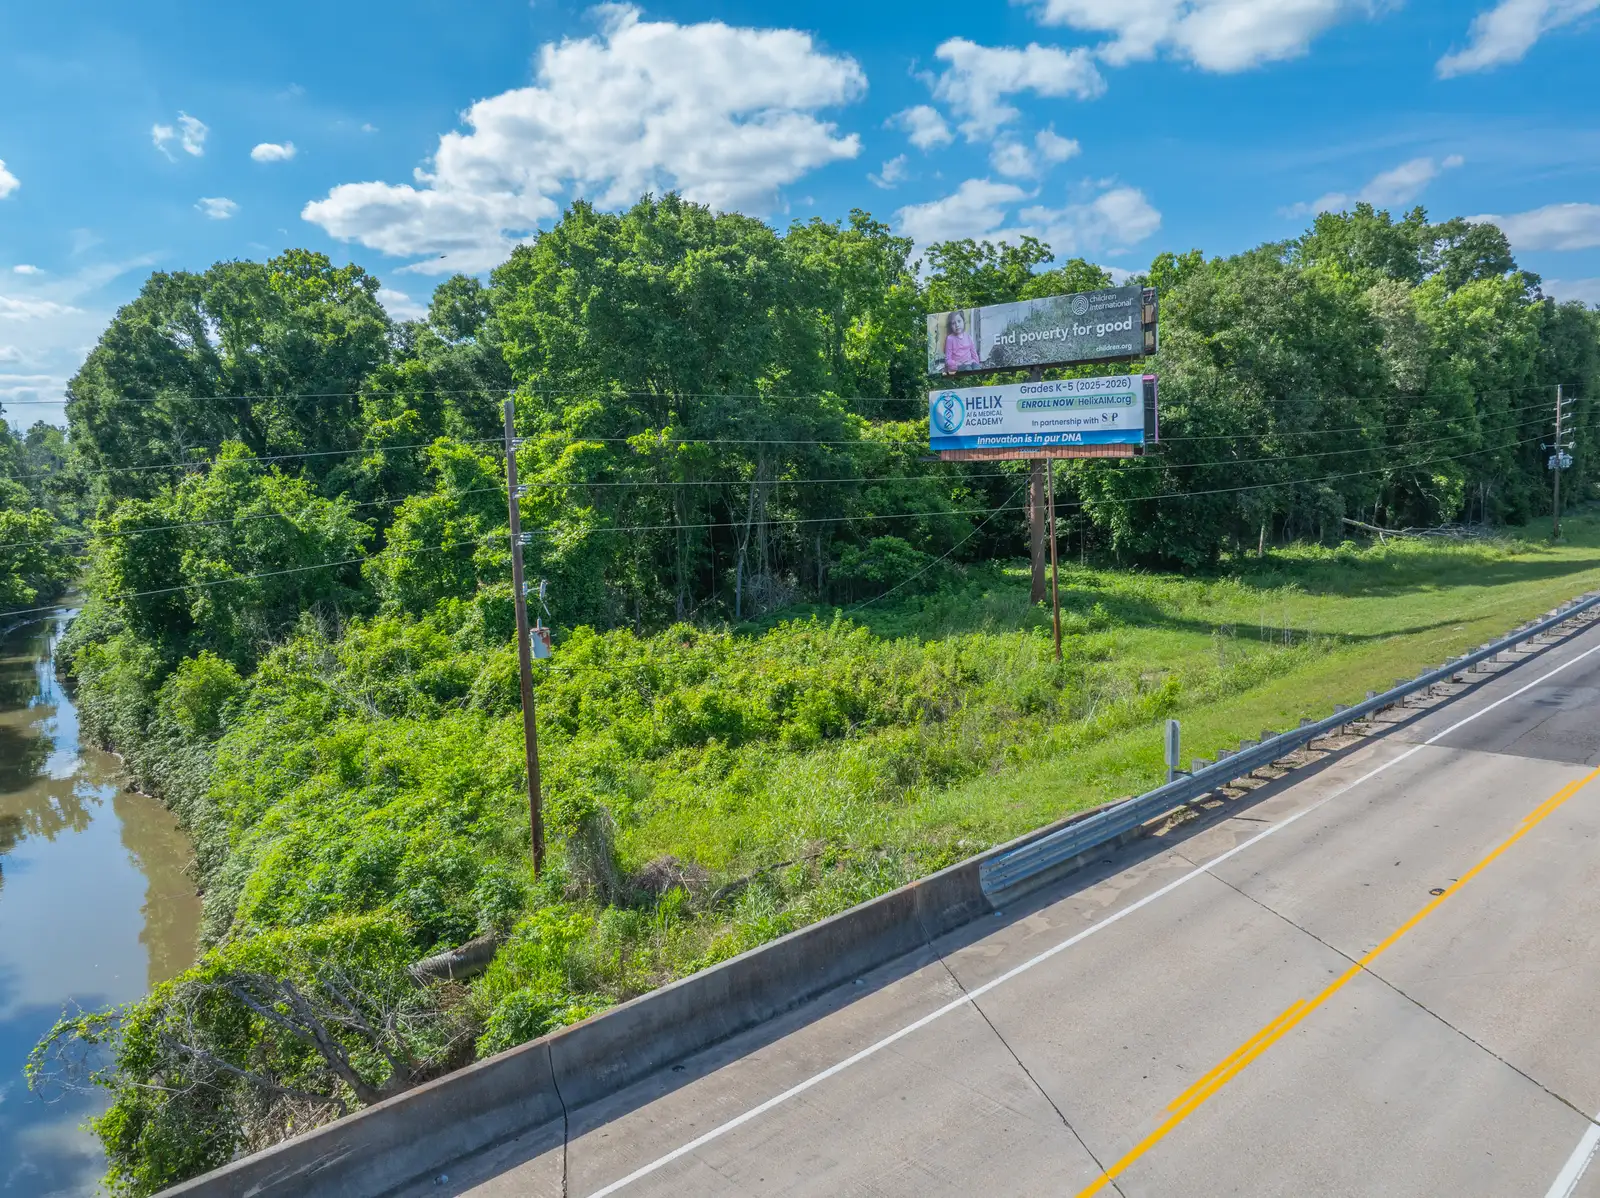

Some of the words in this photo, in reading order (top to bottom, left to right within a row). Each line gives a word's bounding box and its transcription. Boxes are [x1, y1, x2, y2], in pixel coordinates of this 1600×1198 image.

[1090, 294, 1116, 302] children
[994, 332, 1015, 345] End
[1020, 328, 1068, 346] poverty
[1072, 322, 1092, 336] for
[1096, 316, 1132, 337] good
[1096, 343, 1132, 352] children.org
[1020, 385, 1053, 393] Grades
[1056, 382, 1074, 391] K-5
[1076, 377, 1131, 391] (2025-2026)
[966, 396, 1002, 410] HELIX
[1021, 400, 1052, 408] ENROLL
[1053, 398, 1074, 407] NOW
[1078, 395, 1131, 407] HelixAIM.org
[966, 418, 1004, 426] ACADEMY
[1040, 418, 1081, 427] partnership
[977, 434, 1023, 445] Innovation
[1025, 434, 1032, 442] is
[1034, 434, 1042, 442] in
[1062, 433, 1082, 441] DNA
